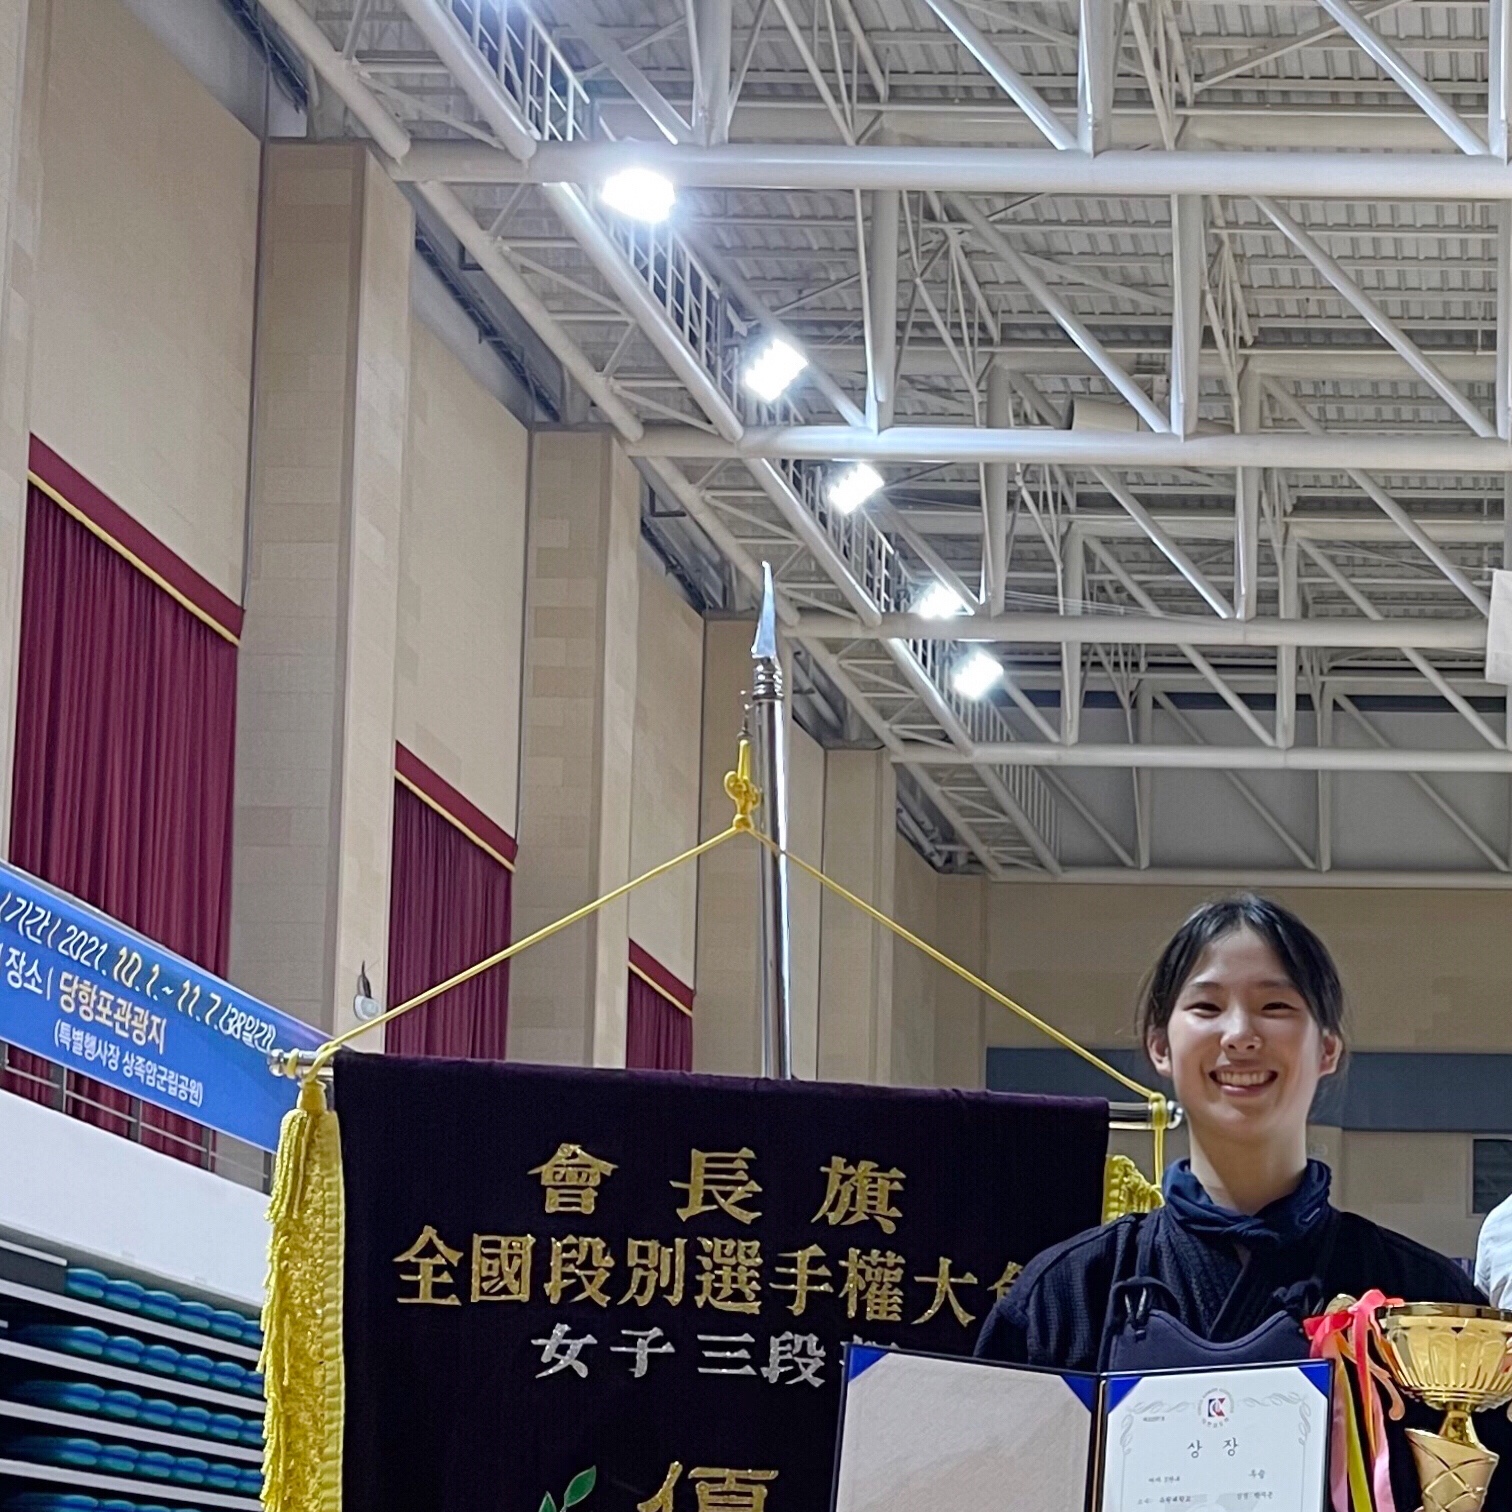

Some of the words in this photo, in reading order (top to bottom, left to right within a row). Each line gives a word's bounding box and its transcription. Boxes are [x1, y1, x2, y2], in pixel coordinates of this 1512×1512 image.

[59, 970, 167, 1056] 당항포관광지
[530, 1321, 899, 1388] 女子三段
